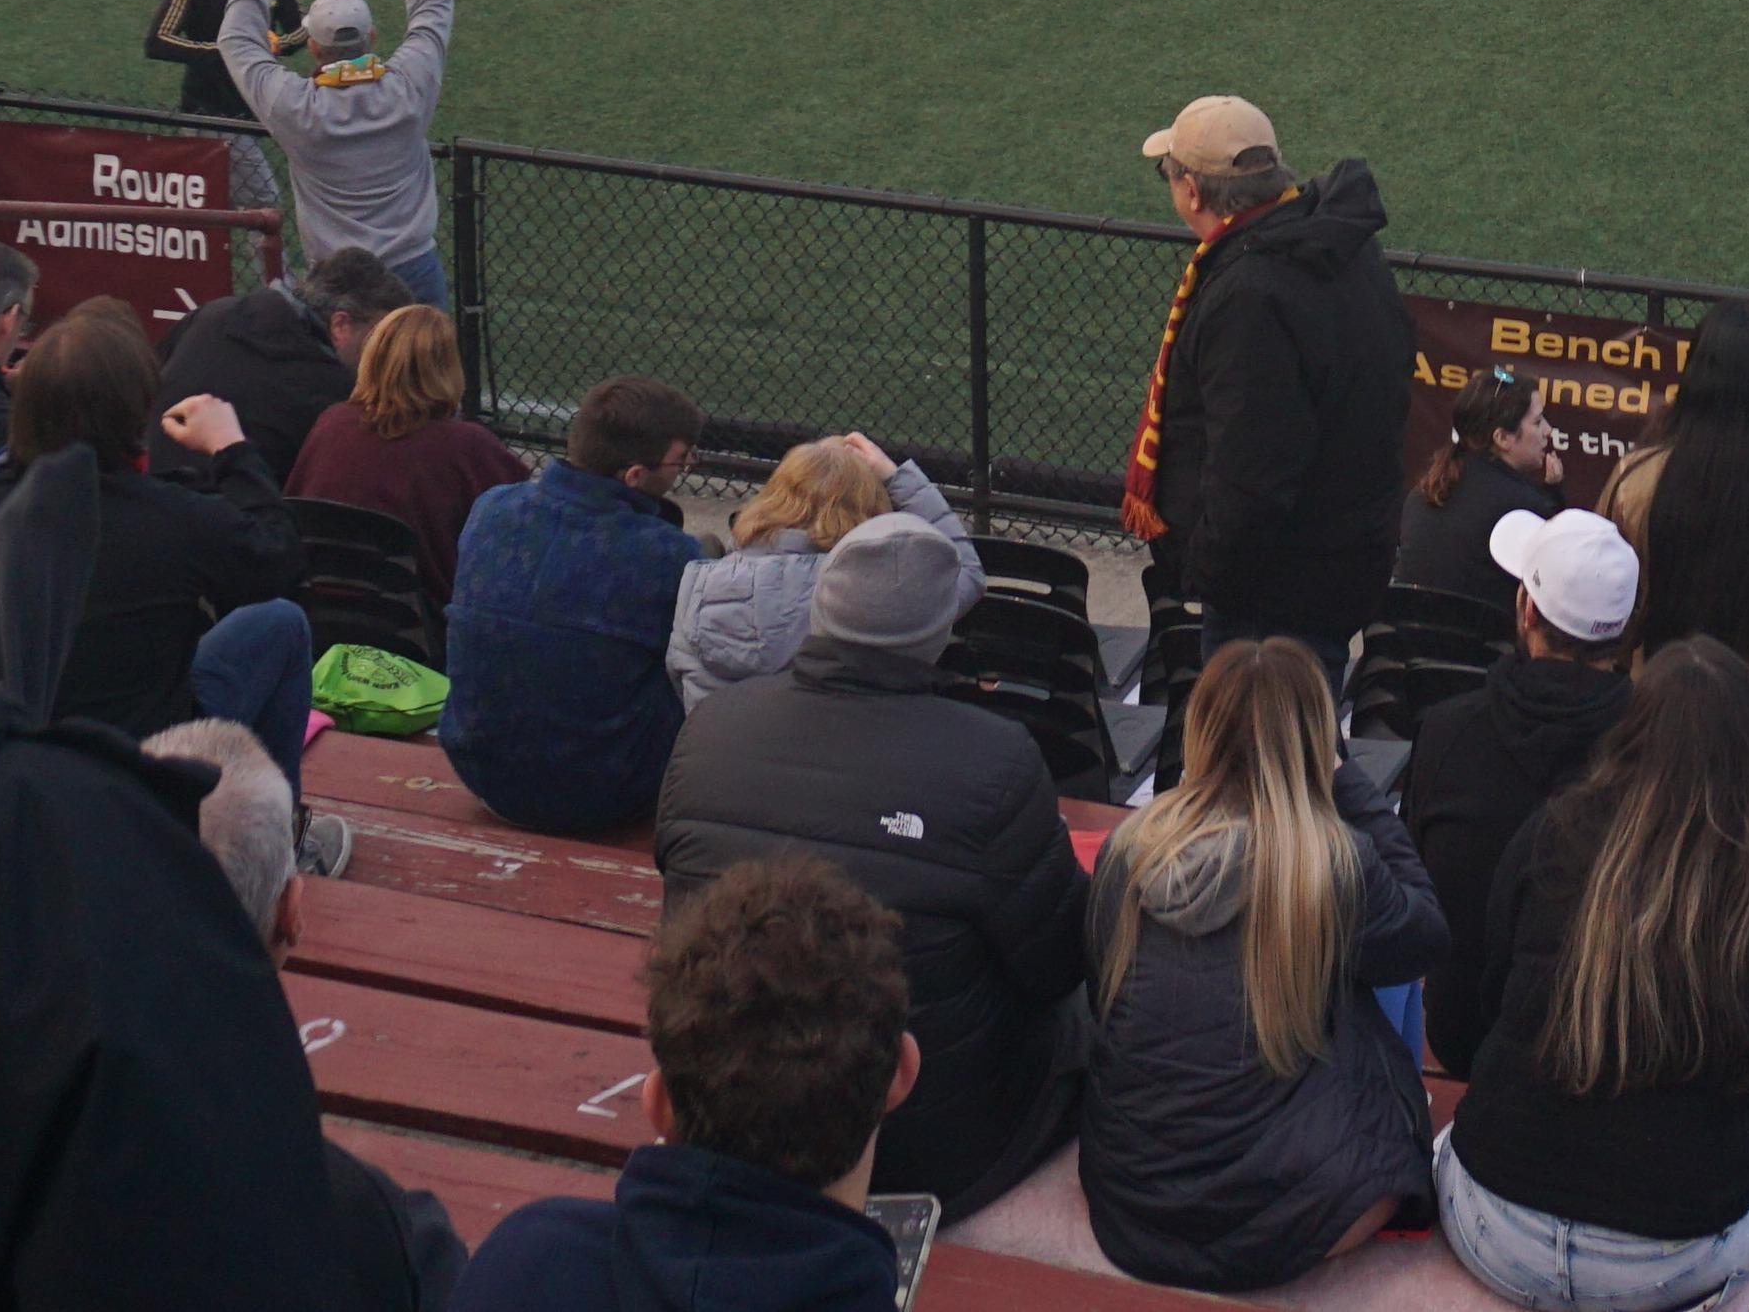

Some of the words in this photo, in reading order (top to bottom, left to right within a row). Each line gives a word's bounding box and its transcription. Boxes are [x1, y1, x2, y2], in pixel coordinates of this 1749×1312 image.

[92, 153, 206, 210] Rouge
[1490, 317, 1663, 372] Bench
[1413, 350, 1651, 415] Asned
